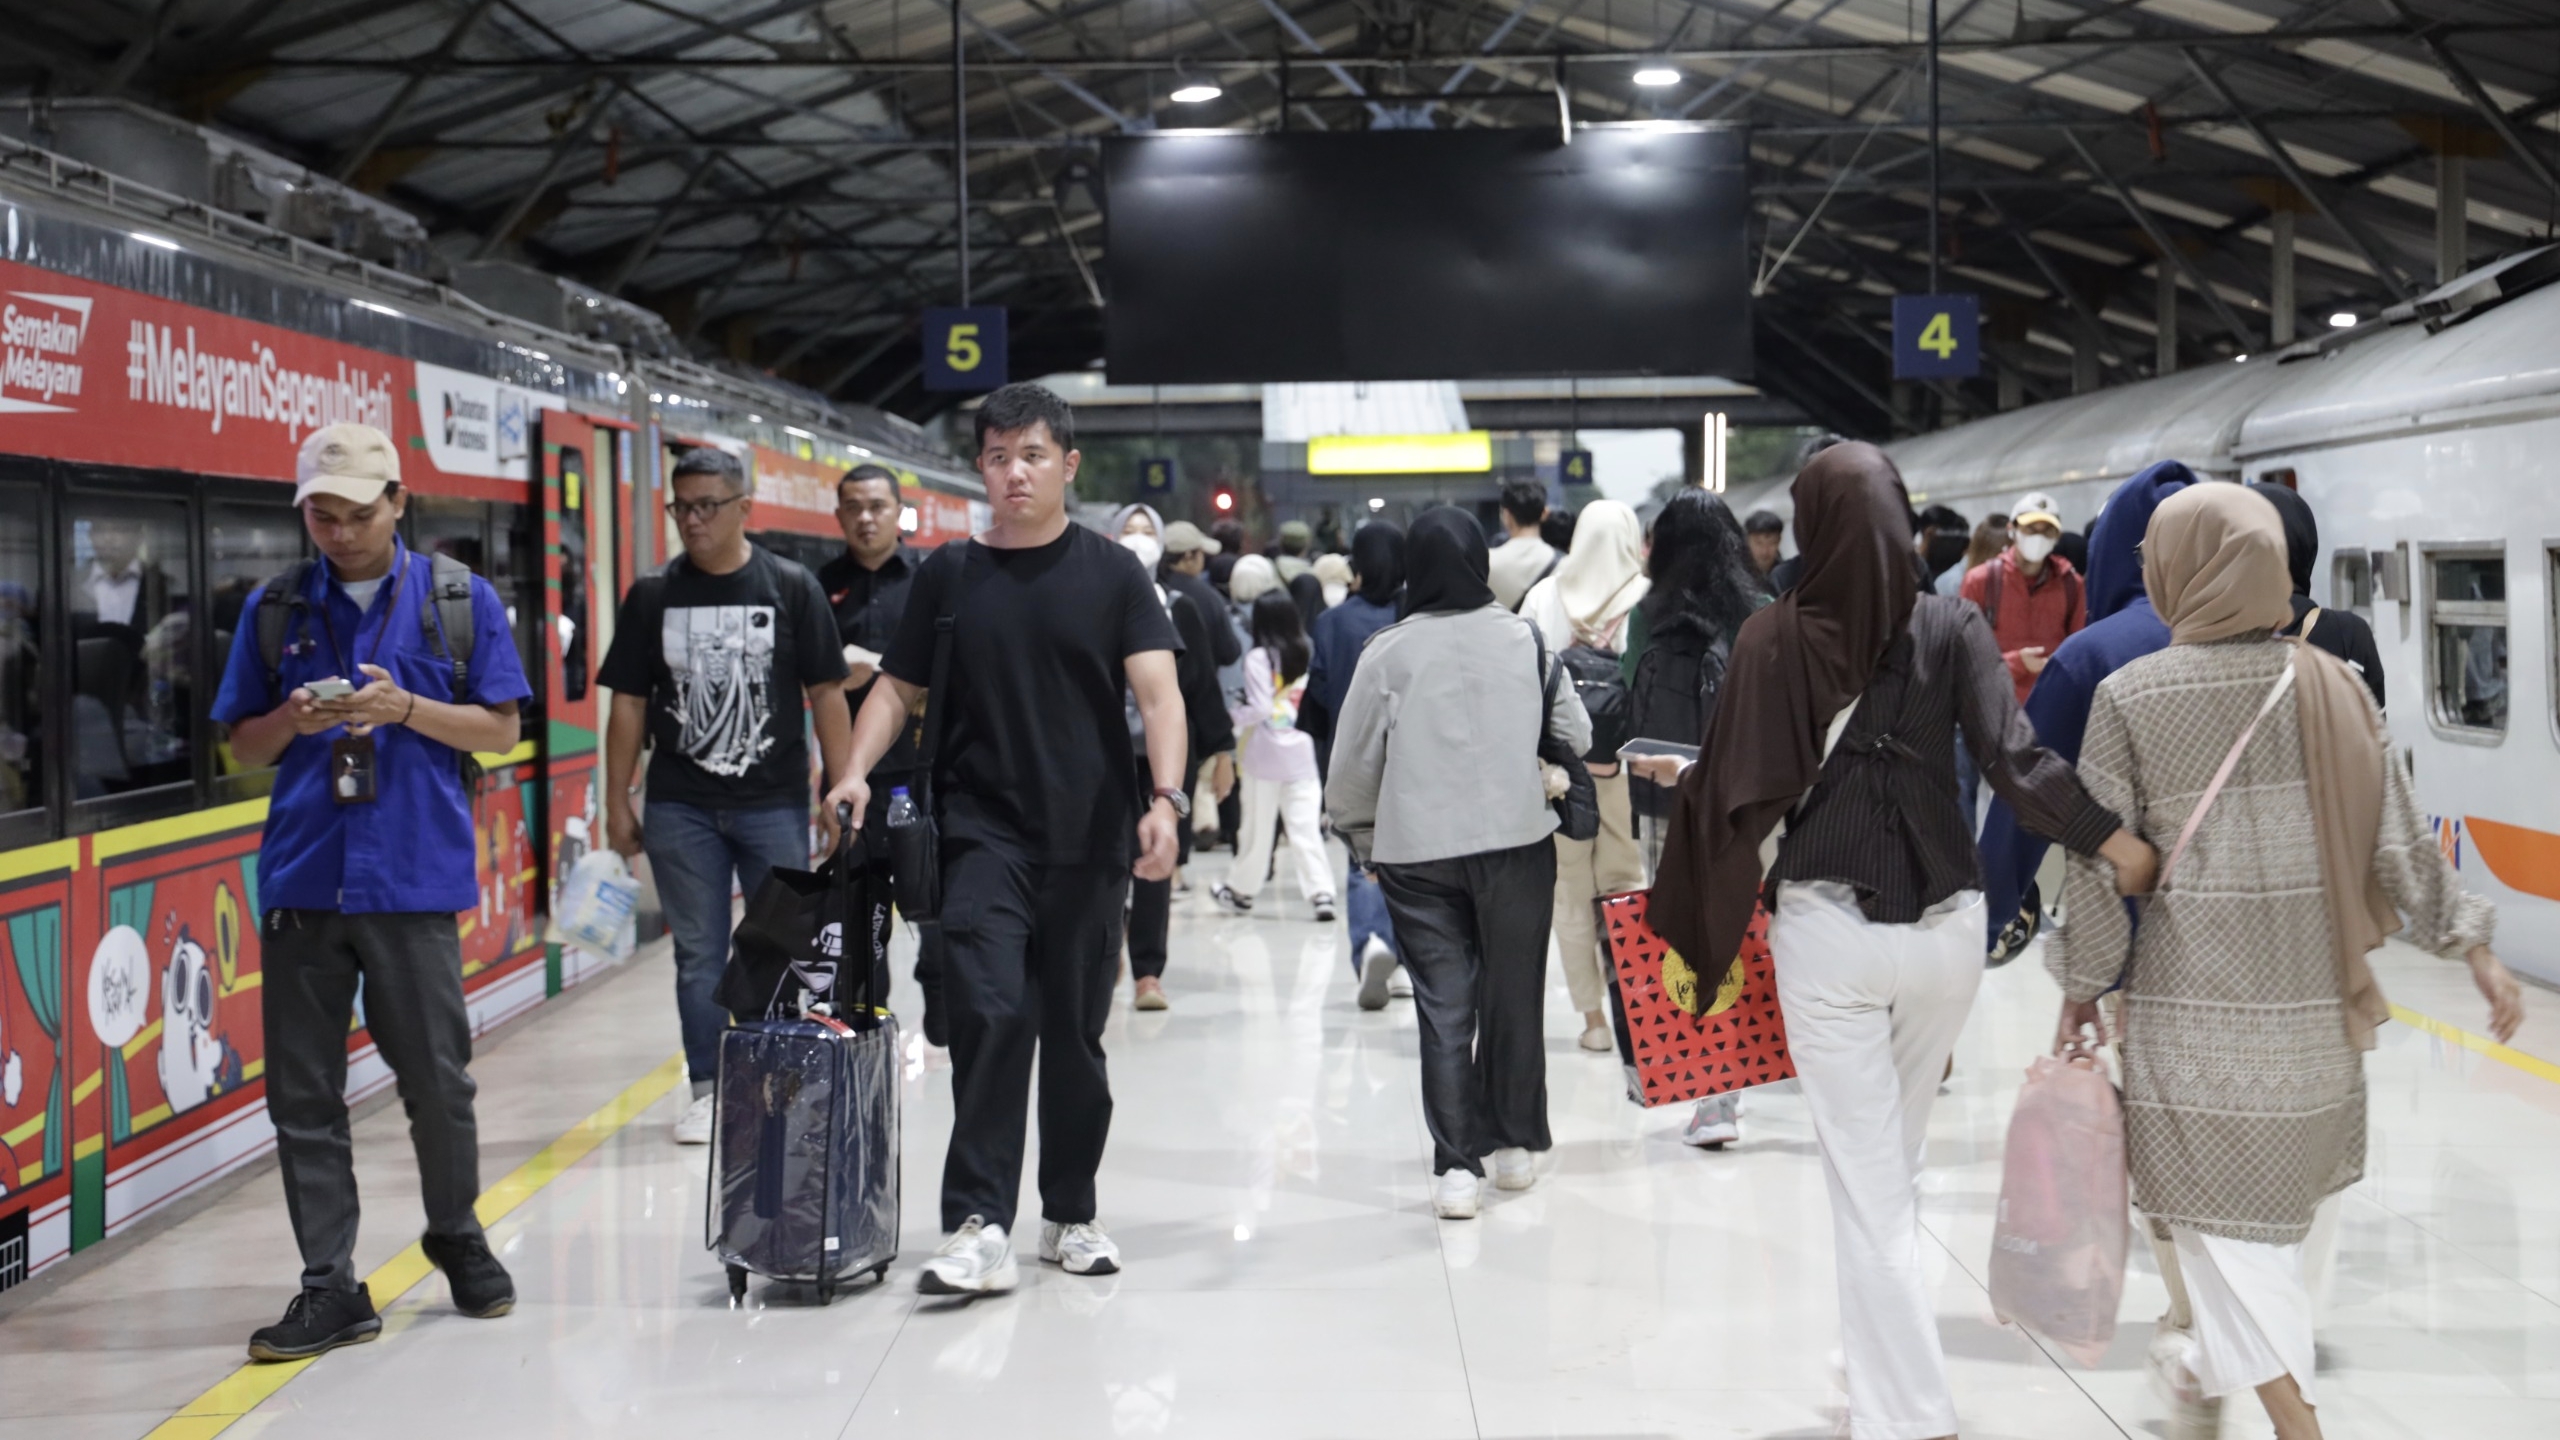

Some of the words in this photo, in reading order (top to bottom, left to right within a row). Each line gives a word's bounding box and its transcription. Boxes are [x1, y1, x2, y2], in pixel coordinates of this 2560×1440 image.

[1, 304, 78, 356] Semakin
[945, 324, 981, 371] 5
[1918, 312, 1957, 359] 4
[4, 346, 83, 402] Melayani
[127, 319, 393, 444] #MelayaniSepenuhHati
[1567, 456, 1585, 478] 4
